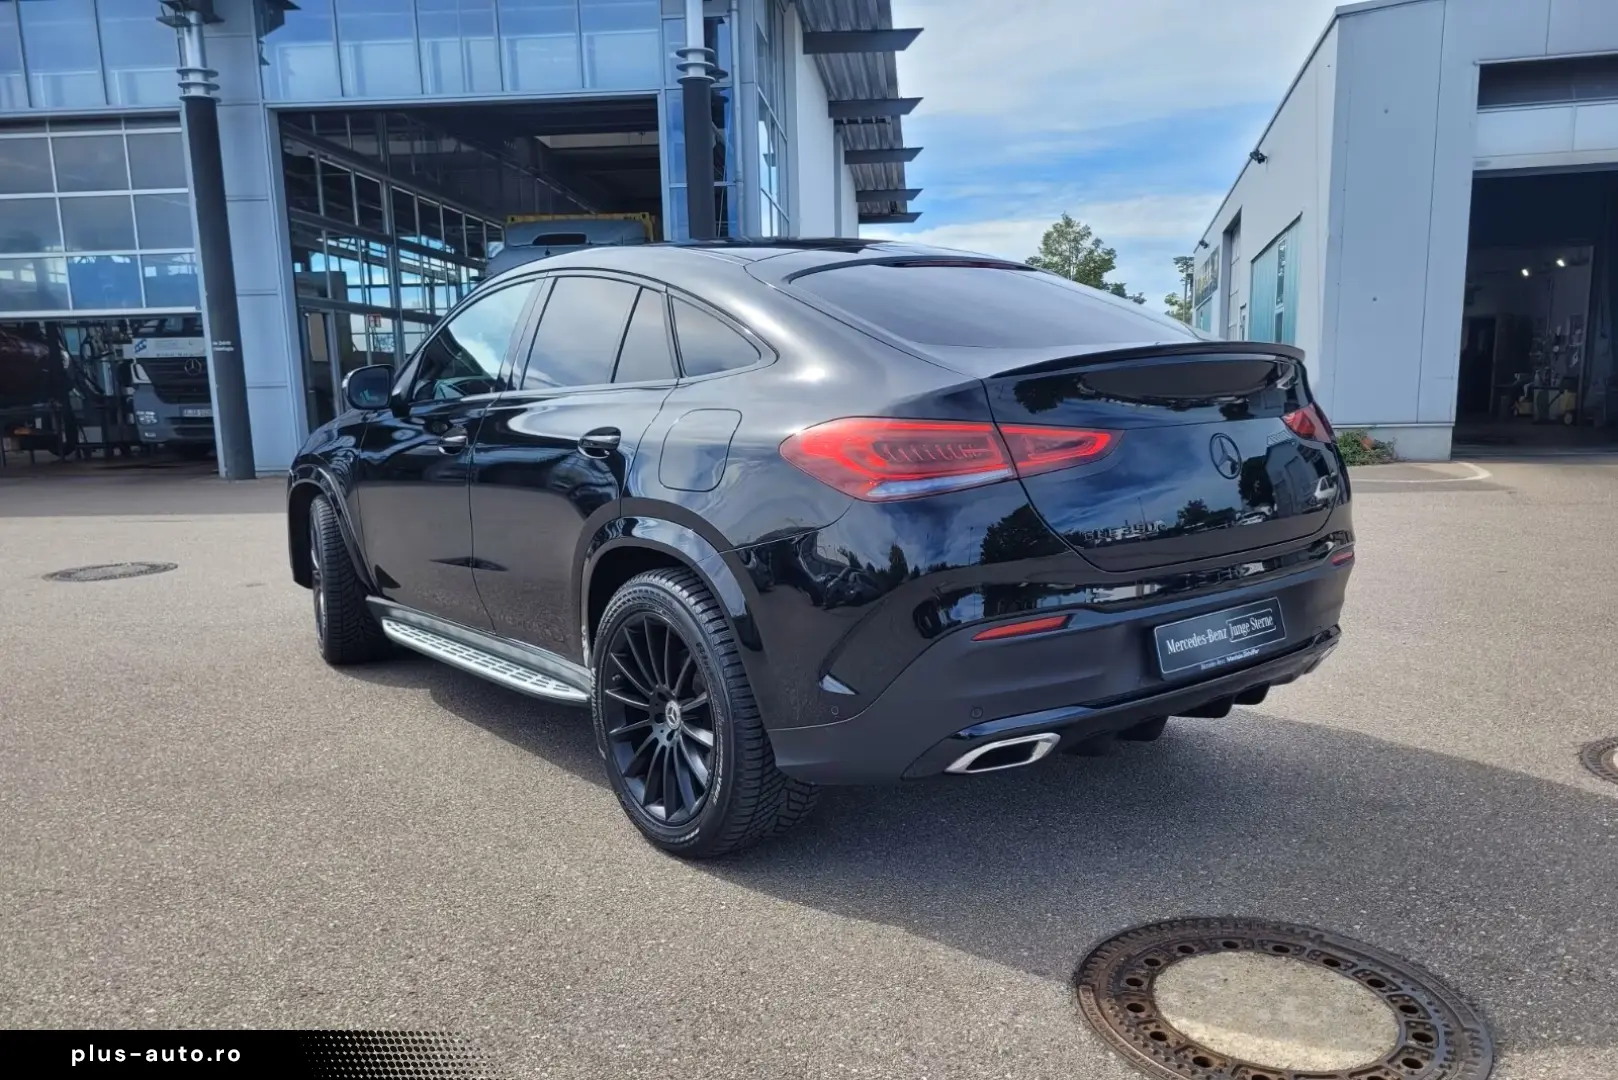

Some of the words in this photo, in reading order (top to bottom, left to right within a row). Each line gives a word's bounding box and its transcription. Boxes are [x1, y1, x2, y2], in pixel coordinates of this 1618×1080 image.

[1166, 628, 1228, 655] Mercedes-Benz
[1229, 621, 1251, 639] Junge
[1249, 615, 1274, 631] Sterne
